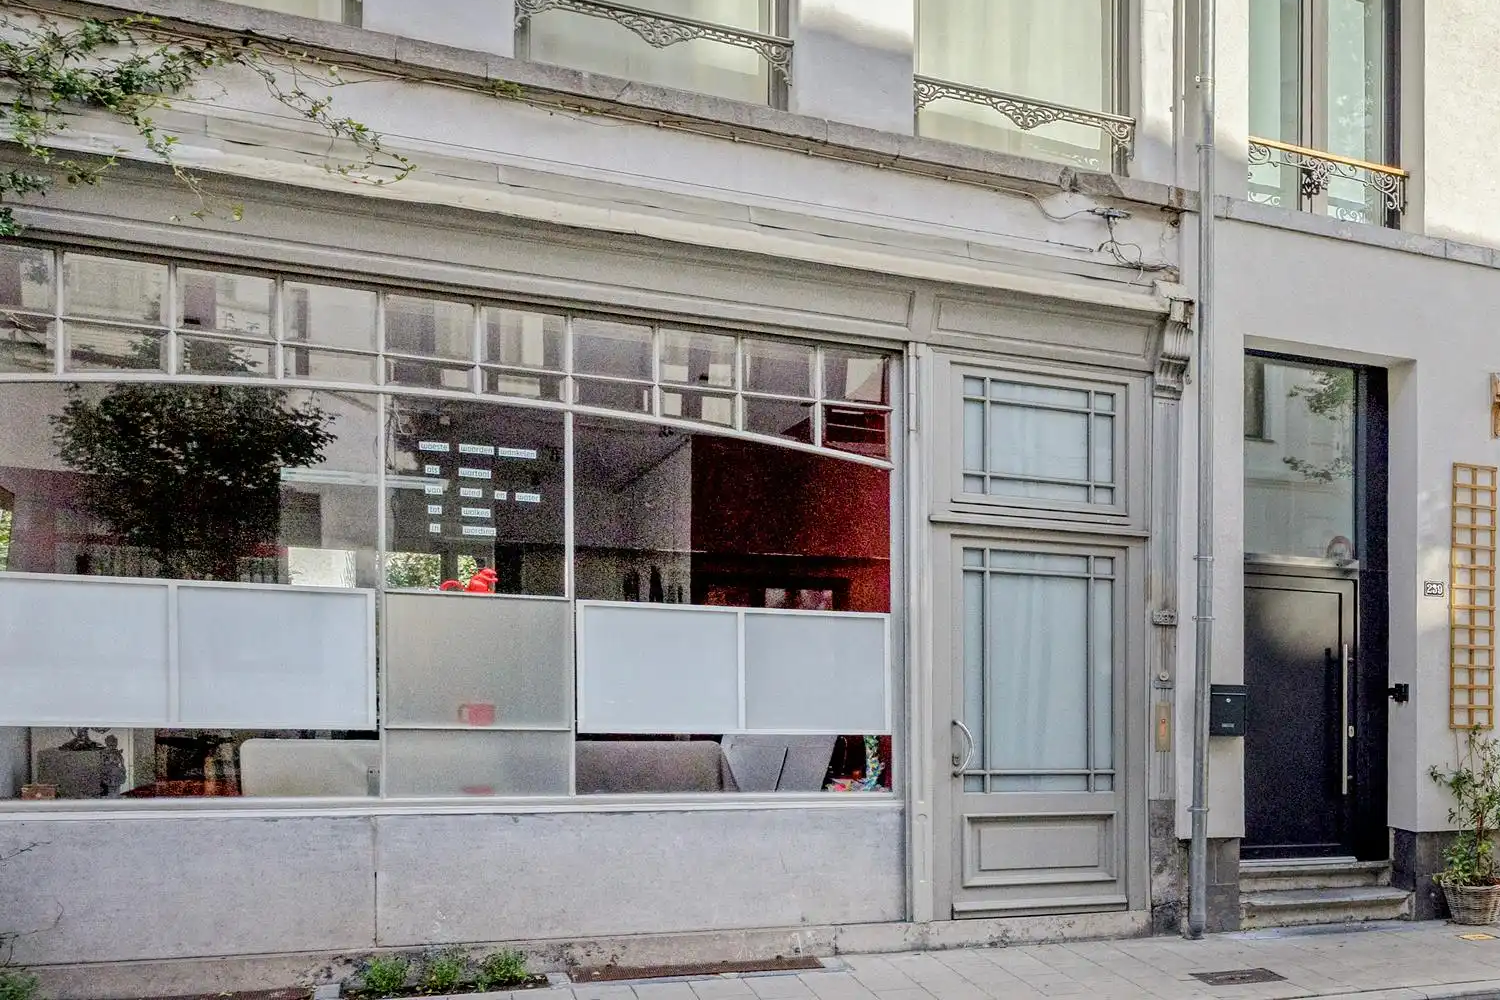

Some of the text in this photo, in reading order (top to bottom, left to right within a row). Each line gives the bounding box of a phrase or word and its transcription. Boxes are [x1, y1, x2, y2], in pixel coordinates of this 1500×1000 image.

[420, 442, 448, 451] woeste
[426, 465, 439, 473] als
[426, 486, 539, 501] van wind en water
[429, 505, 441, 513] tot
[431, 524, 496, 535] in wording
[1426, 583, 1443, 594] 239
[1457, 663, 1472, 676] 243
